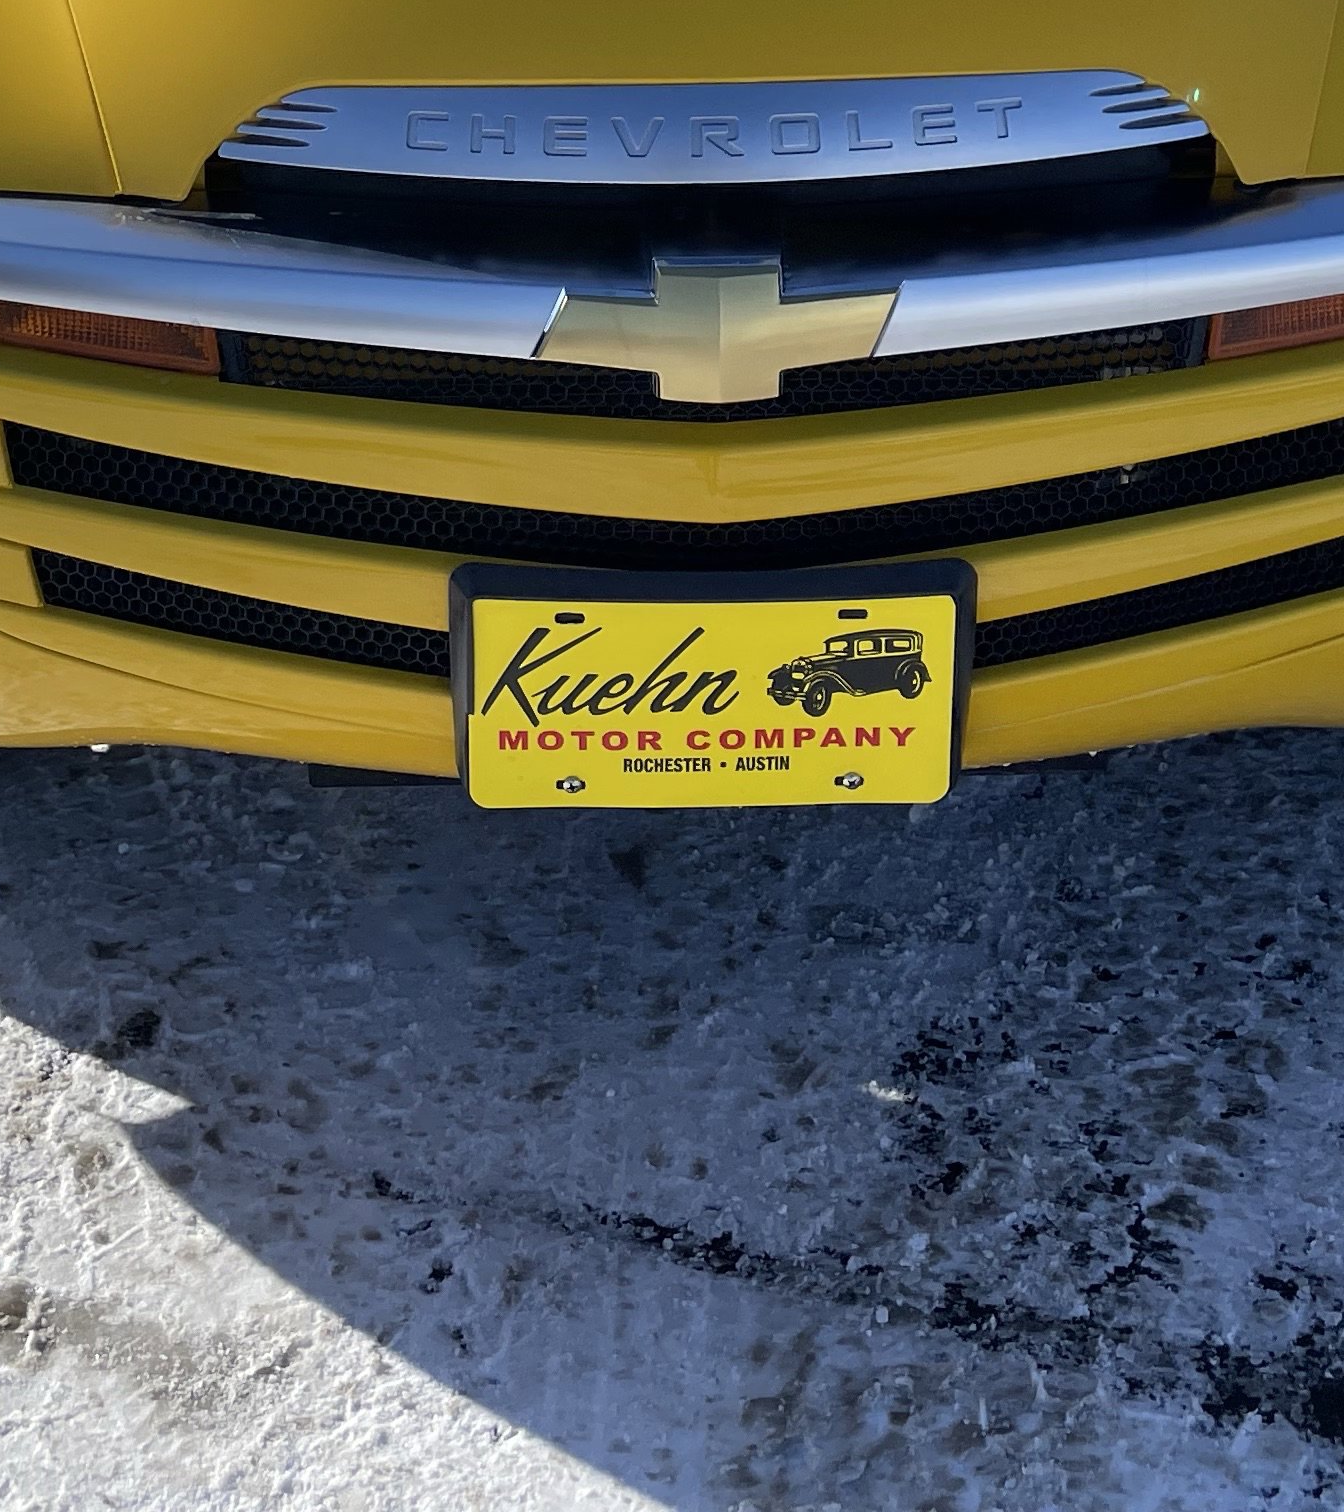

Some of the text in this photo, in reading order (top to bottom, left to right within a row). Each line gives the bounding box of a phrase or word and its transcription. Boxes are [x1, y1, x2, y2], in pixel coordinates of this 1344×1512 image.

[406, 97, 1024, 158] CHEVROLET
[482, 626, 740, 727] Kuehn
[499, 726, 917, 752] MOTOR COMPANY
[623, 755, 790, 774] ROCHESTER AUSTIN
